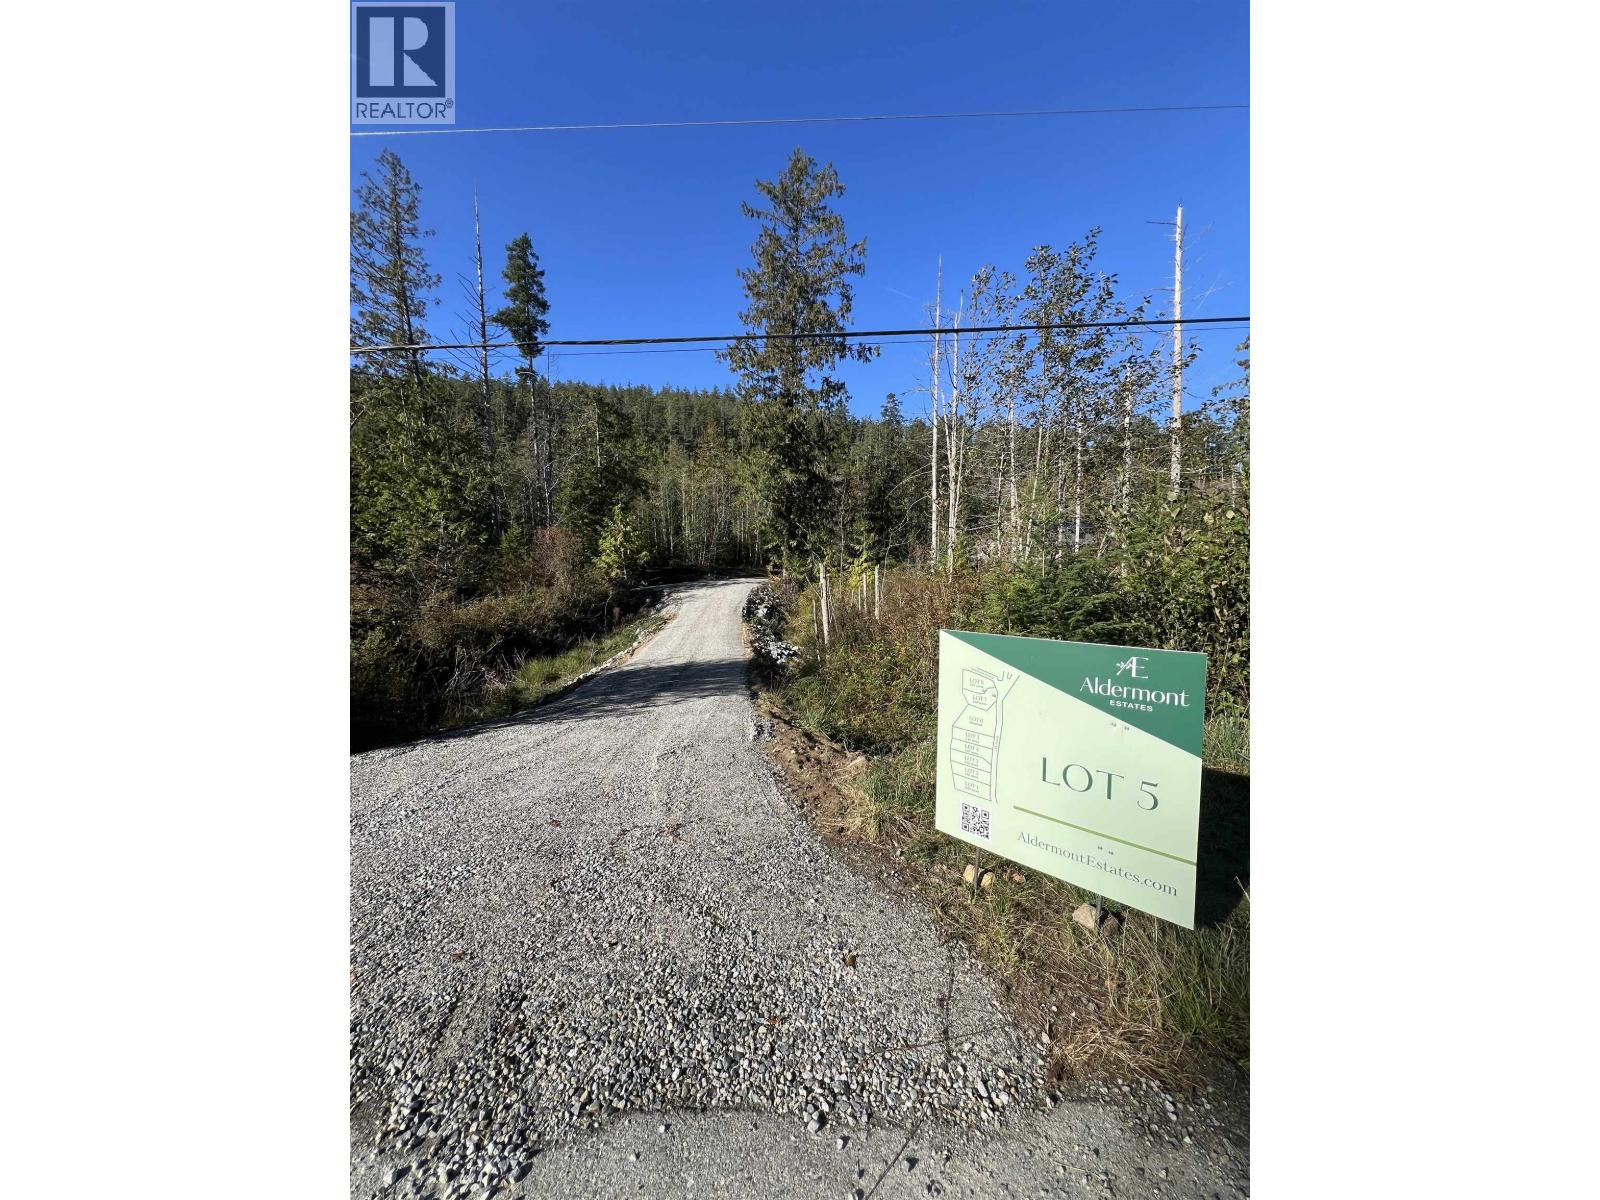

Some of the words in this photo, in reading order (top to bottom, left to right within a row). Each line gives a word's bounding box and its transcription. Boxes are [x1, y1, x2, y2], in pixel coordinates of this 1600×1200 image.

[1080, 676, 1190, 707] Aldermont
[1109, 699, 1153, 712] ESTATES
[1041, 757, 1125, 800] LOT
[1137, 780, 1159, 811] 5
[1017, 831, 1178, 897] AldermontEstates.com
